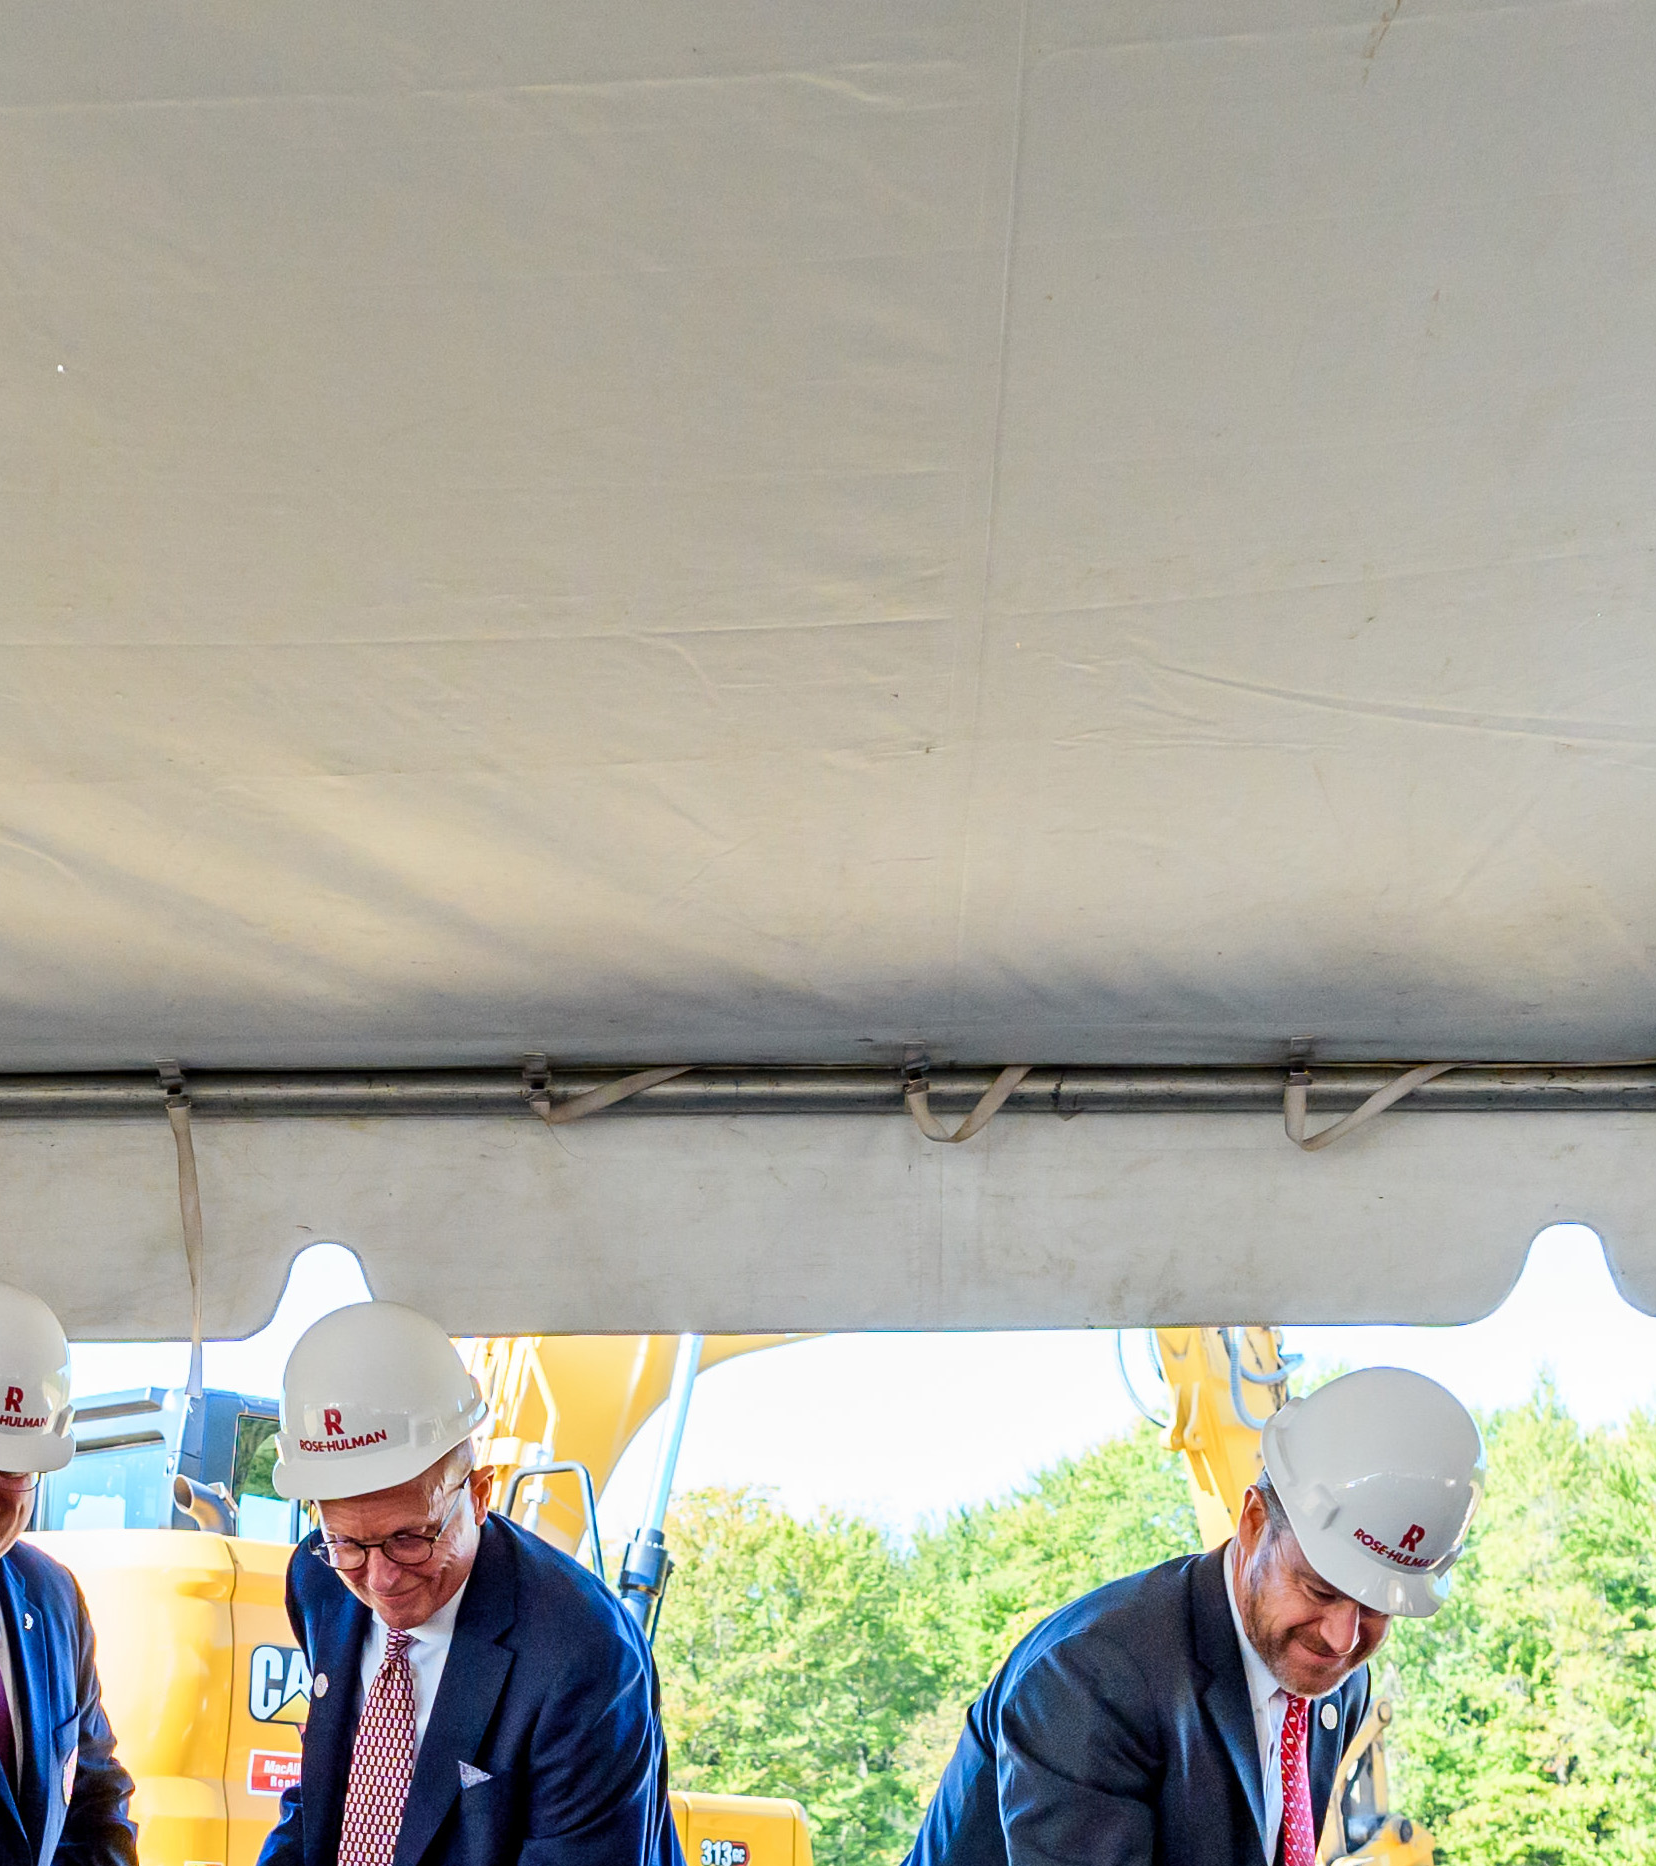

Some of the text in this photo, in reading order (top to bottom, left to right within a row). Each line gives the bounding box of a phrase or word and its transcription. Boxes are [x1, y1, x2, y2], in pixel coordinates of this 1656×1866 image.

[5, 1386, 24, 1413] R
[324, 1408, 345, 1436] R
[299, 1429, 387, 1452] ROSE-HULMAN
[1399, 1524, 1426, 1552] R
[252, 1646, 313, 1720] CA
[264, 1760, 301, 1775] MacAll
